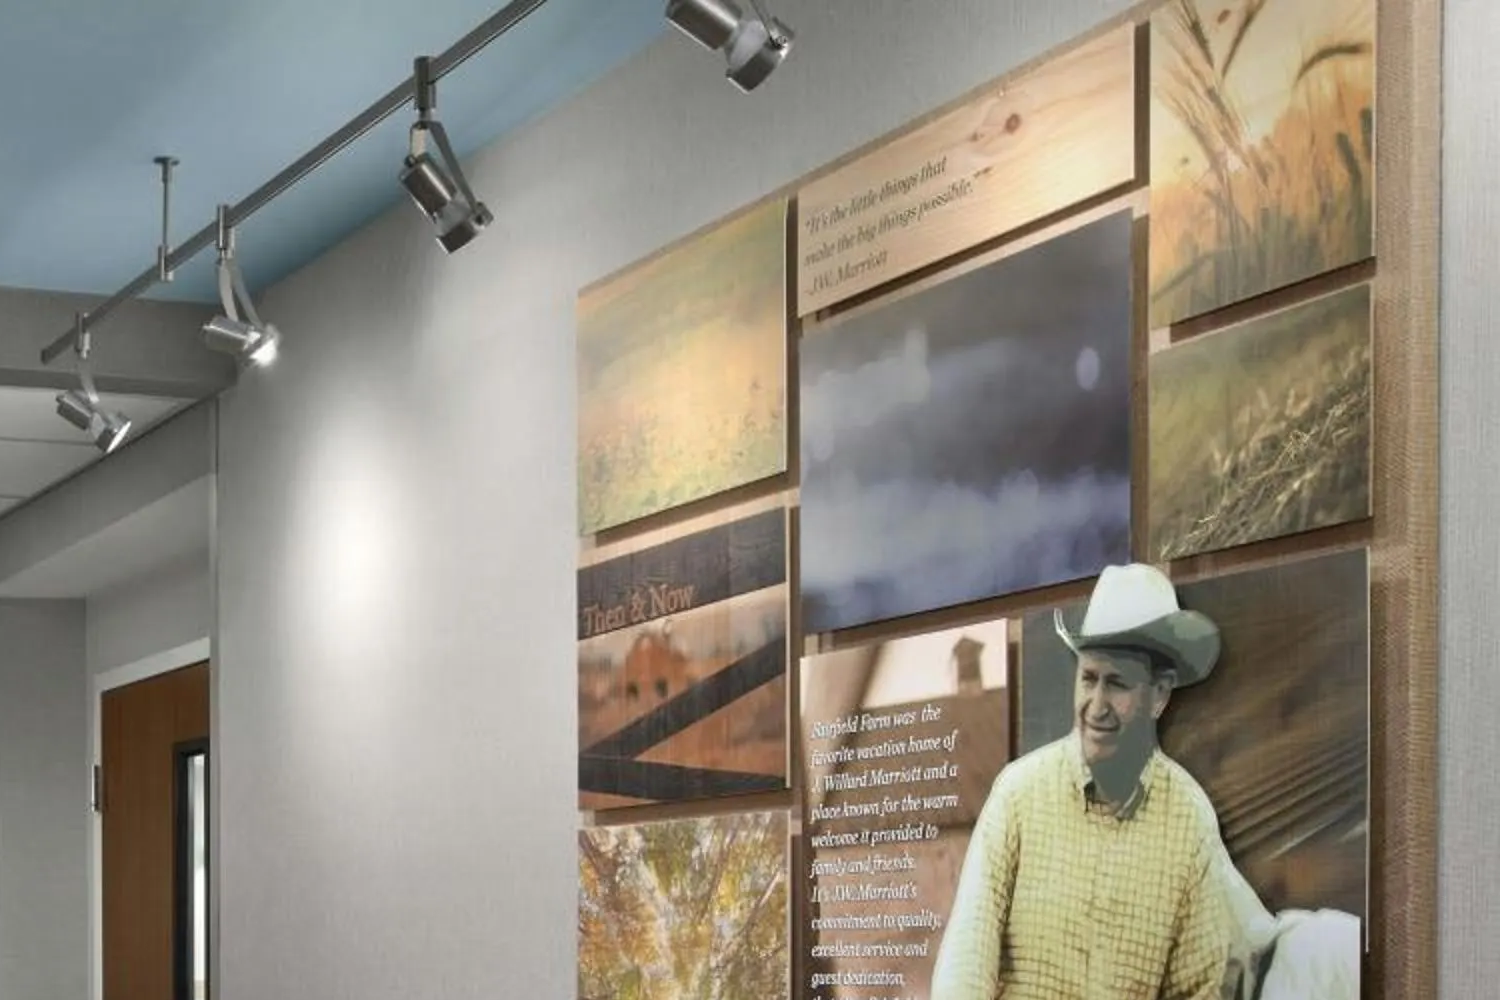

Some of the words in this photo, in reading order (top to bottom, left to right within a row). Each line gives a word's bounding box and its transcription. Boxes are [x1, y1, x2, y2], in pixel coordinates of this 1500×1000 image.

[829, 204, 847, 225] the
[849, 189, 878, 217] little
[879, 174, 918, 204] things
[919, 155, 947, 183] that
[837, 232, 855, 253] the
[857, 223, 876, 243] big
[877, 206, 917, 234] things
[838, 250, 887, 282] Marriott
[583, 603, 627, 635] Then
[629, 586, 646, 623] &
[648, 582, 696, 616] Now
[860, 713, 891, 731] Farm
[893, 711, 917, 726] was
[921, 703, 941, 722] the
[908, 735, 941, 753] home
[943, 728, 959, 752] of
[823, 764, 868, 792] Willard
[867, 766, 920, 787] Marriott
[922, 760, 949, 780] and
[949, 764, 959, 777] a
[809, 803, 841, 825] place
[843, 801, 880, 817] known
[880, 796, 900, 817] for
[901, 793, 921, 812] the
[922, 795, 959, 810] warm
[810, 829, 859, 848] welcome
[860, 829, 869, 843] it
[870, 822, 924, 847] provided
[925, 822, 940, 840] to
[809, 857, 846, 879] family
[847, 854, 871, 874] and
[811, 913, 881, 930] commitment
[883, 913, 896, 928] to
[811, 940, 860, 957] excellent
[861, 939, 902, 957] service
[903, 938, 928, 957] and
[811, 971, 842, 989] guest
